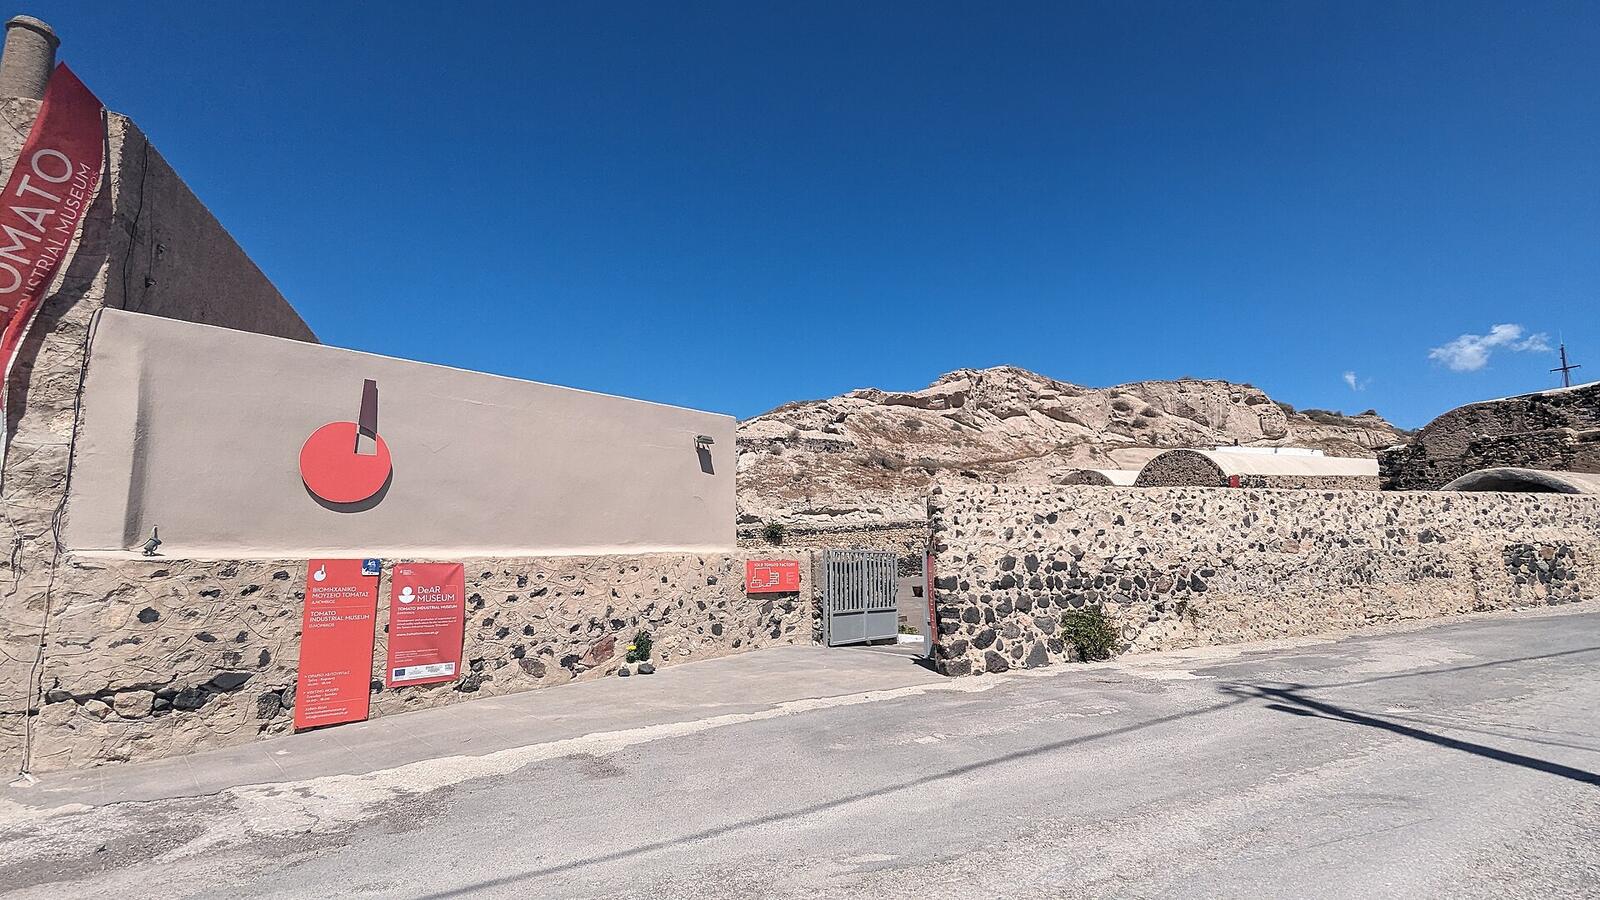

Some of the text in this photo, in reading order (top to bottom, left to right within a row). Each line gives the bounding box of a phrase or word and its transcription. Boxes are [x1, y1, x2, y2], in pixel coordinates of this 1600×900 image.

[55, 162, 91, 236] MUSEUM
[0, 149, 73, 313] OMATO
[417, 585, 441, 594] DeAR
[417, 594, 455, 603] MUSEUM
